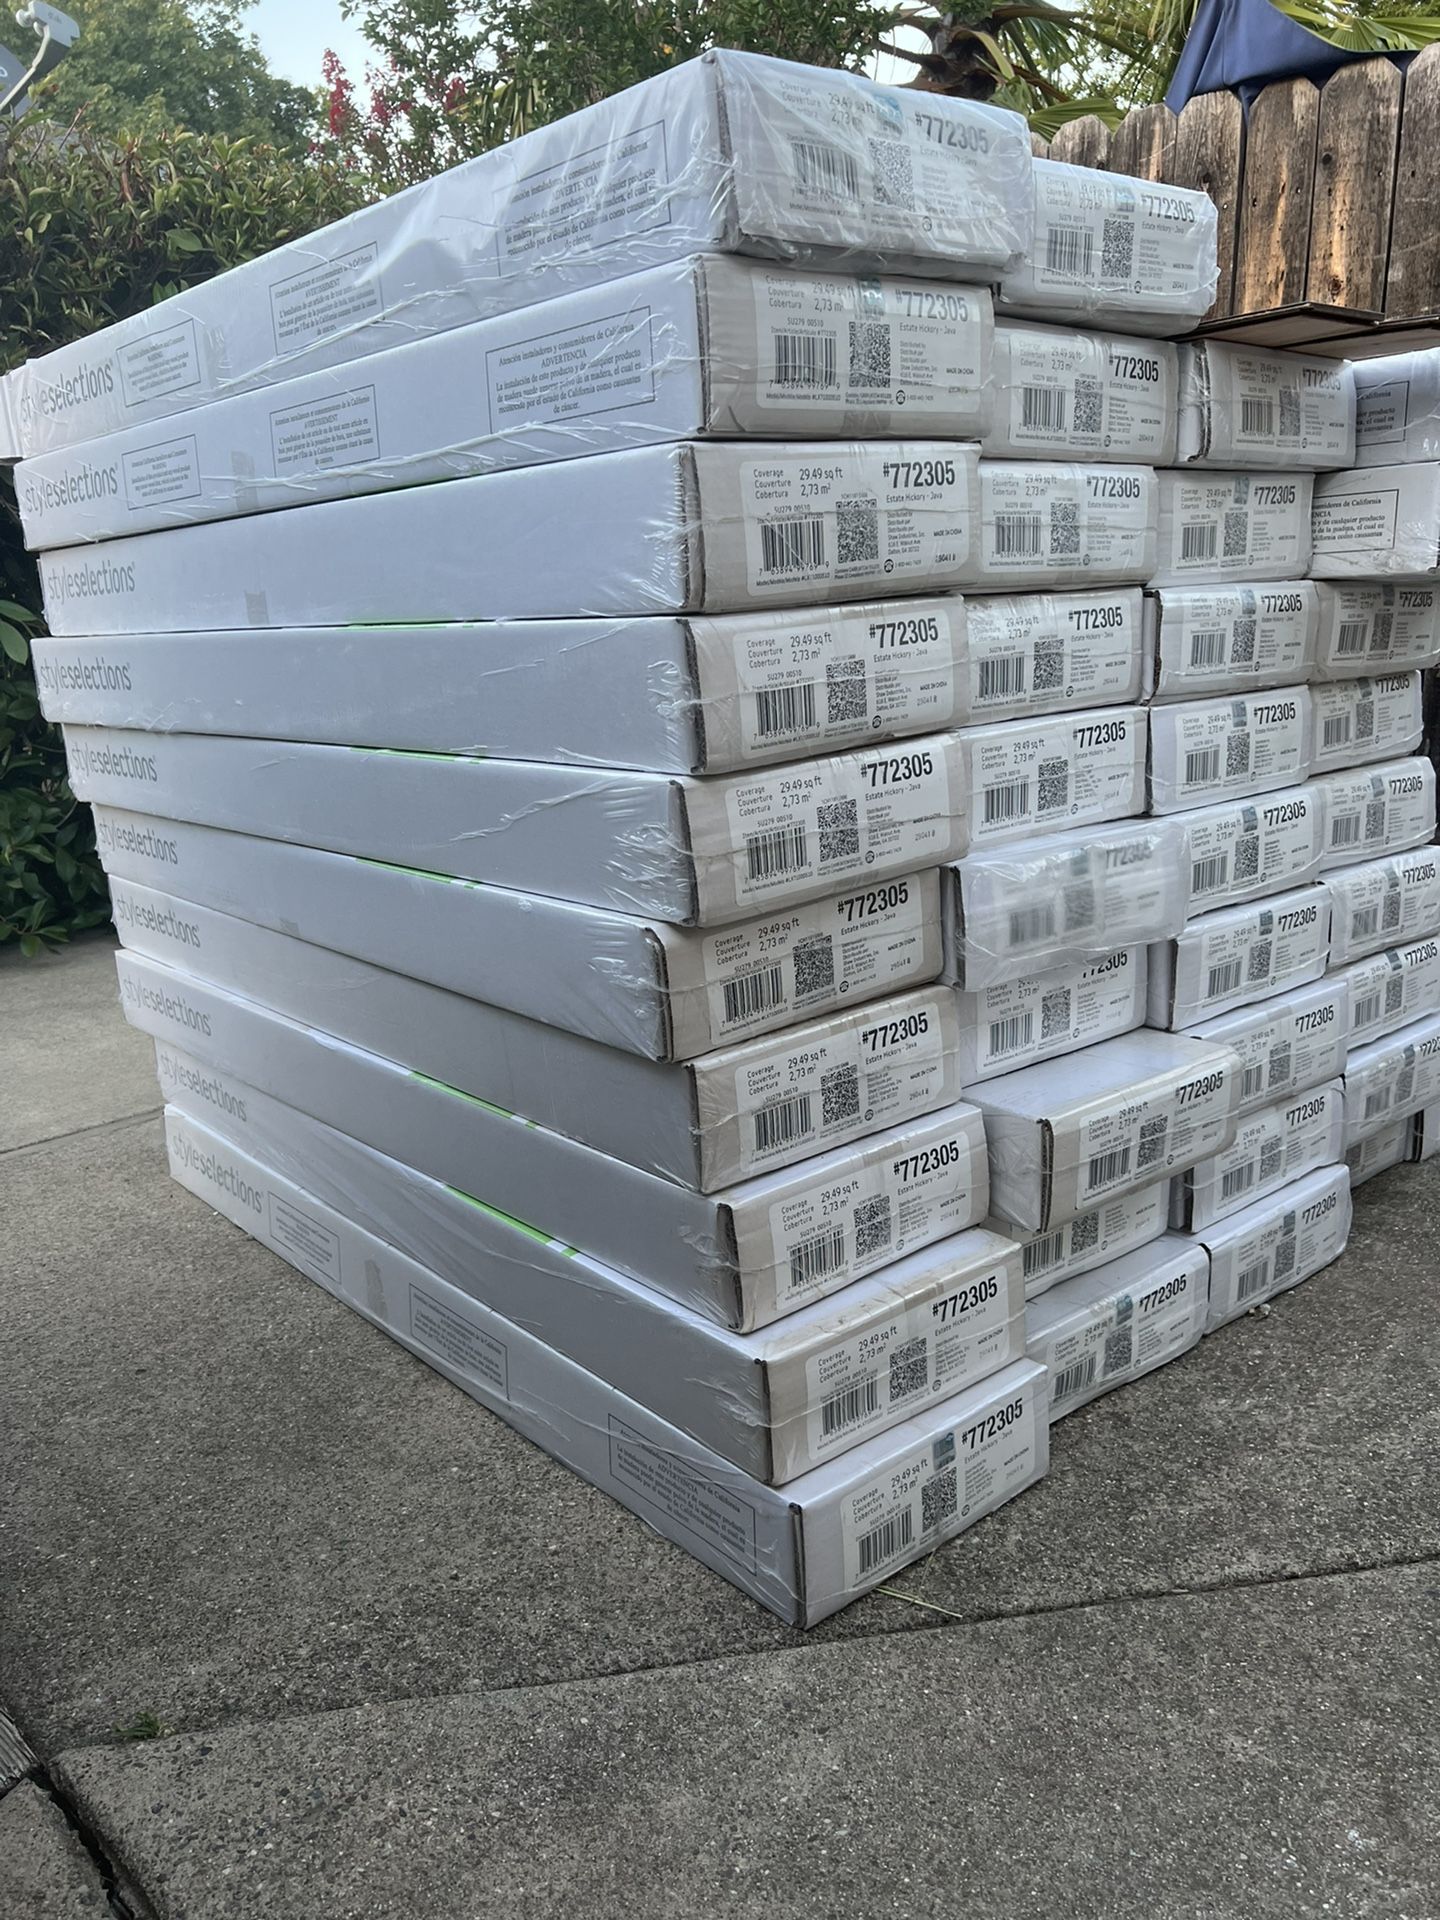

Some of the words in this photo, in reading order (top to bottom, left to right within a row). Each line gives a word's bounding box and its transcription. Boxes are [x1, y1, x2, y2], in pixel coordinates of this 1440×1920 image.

[896, 288, 967, 320] #772305
[541, 349, 587, 368] ADVERTENCIA
[615, 350, 641, 364] producto
[1109, 353, 1158, 382] #772305
[752, 468, 783, 477] Coverage
[799, 467, 822, 480] 29.49
[824, 469, 833, 480] sq
[834, 466, 843, 478] ft
[883, 460, 954, 487] #772305
[754, 479, 790, 488] Couverture
[800, 483, 819, 497] 2,73
[1086, 474, 1139, 497] #772305
[755, 490, 788, 499] Cobertura
[886, 494, 904, 503] Estate
[906, 493, 925, 501] Hickory
[930, 491, 942, 499] Java
[1254, 485, 1294, 504] #772305
[1343, 500, 1350, 508] de
[1352, 498, 1381, 507] California
[1359, 514, 1385, 523] producto
[1364, 522, 1376, 530] cual
[49, 560, 135, 604] styleselections
[1262, 593, 1302, 612] #772305
[1400, 591, 1433, 608] #772305
[1068, 606, 1122, 629] #772305
[790, 633, 812, 647] 29.49
[813, 634, 823, 645] sq
[823, 631, 831, 642] ft
[869, 618, 937, 647] #772305
[746, 638, 775, 648] Coverage
[748, 648, 782, 658] Couverture
[792, 648, 809, 662] 2,73
[749, 658, 780, 668] Cobertura
[40, 658, 131, 694] styleselections
[1254, 702, 1295, 723] #772305
[1073, 722, 1125, 749] #772305
[1013, 740, 1029, 752] 29.49
[72, 743, 157, 781] styleselections
[861, 752, 932, 786] #772305
[735, 786, 764, 797] Coverage
[780, 778, 802, 793] 29.49
[804, 778, 813, 789] sq
[814, 775, 822, 785] ft
[865, 791, 883, 801] Estate
[885, 787, 904, 795] Hickory
[909, 783, 921, 791] Java
[737, 794, 772, 807] Couverture
[782, 793, 799, 807] 2,73
[738, 804, 770, 816] Cobertura
[1264, 801, 1306, 826] #772305
[100, 817, 178, 864] styleselections
[838, 882, 907, 921] #772305
[118, 895, 200, 948] styleselections
[757, 922, 779, 938] 29.49
[781, 921, 790, 931] sq
[791, 917, 799, 927] ft
[841, 924, 859, 935] Estate
[860, 918, 879, 927] Hickory
[884, 912, 896, 921] Java
[1279, 906, 1317, 932] #772305
[714, 934, 742, 948] Coverage
[715, 941, 749, 956] Couverture
[759, 937, 776, 951] 2,73
[716, 950, 747, 965] Cobertura
[1404, 941, 1437, 966] #772305
[124, 979, 211, 1036] styleselections
[1295, 1004, 1333, 1032] #772305
[862, 1013, 927, 1050] #772305
[787, 1053, 808, 1069] 29.49
[809, 1052, 818, 1061] sq
[819, 1047, 826, 1057] ft
[747, 1065, 773, 1078] Coverage
[748, 1071, 780, 1086] Couverture
[789, 1067, 805, 1081] 2,73
[161, 1052, 247, 1122] styleselections
[749, 1081, 778, 1095] Cobertura
[1175, 1071, 1223, 1104] #772305
[1286, 1095, 1325, 1125] #772305
[894, 1141, 958, 1182] #772305
[173, 1132, 261, 1213] styleselections
[820, 1186, 840, 1203] 29.49
[842, 1185, 851, 1194] sq
[851, 1180, 859, 1190] ft
[779, 1200, 806, 1214] Coverage
[781, 1206, 813, 1223] Couverture
[822, 1200, 838, 1215] 2,73
[1302, 1192, 1337, 1224] #772305
[782, 1216, 811, 1231] Cobertura
[932, 1277, 997, 1321] #772305
[1139, 1274, 1187, 1312] #772305
[817, 1350, 844, 1366] Coverage
[819, 1355, 850, 1374] Couverture
[820, 1365, 848, 1382] Cobertura
[962, 1399, 1022, 1449] #772305
